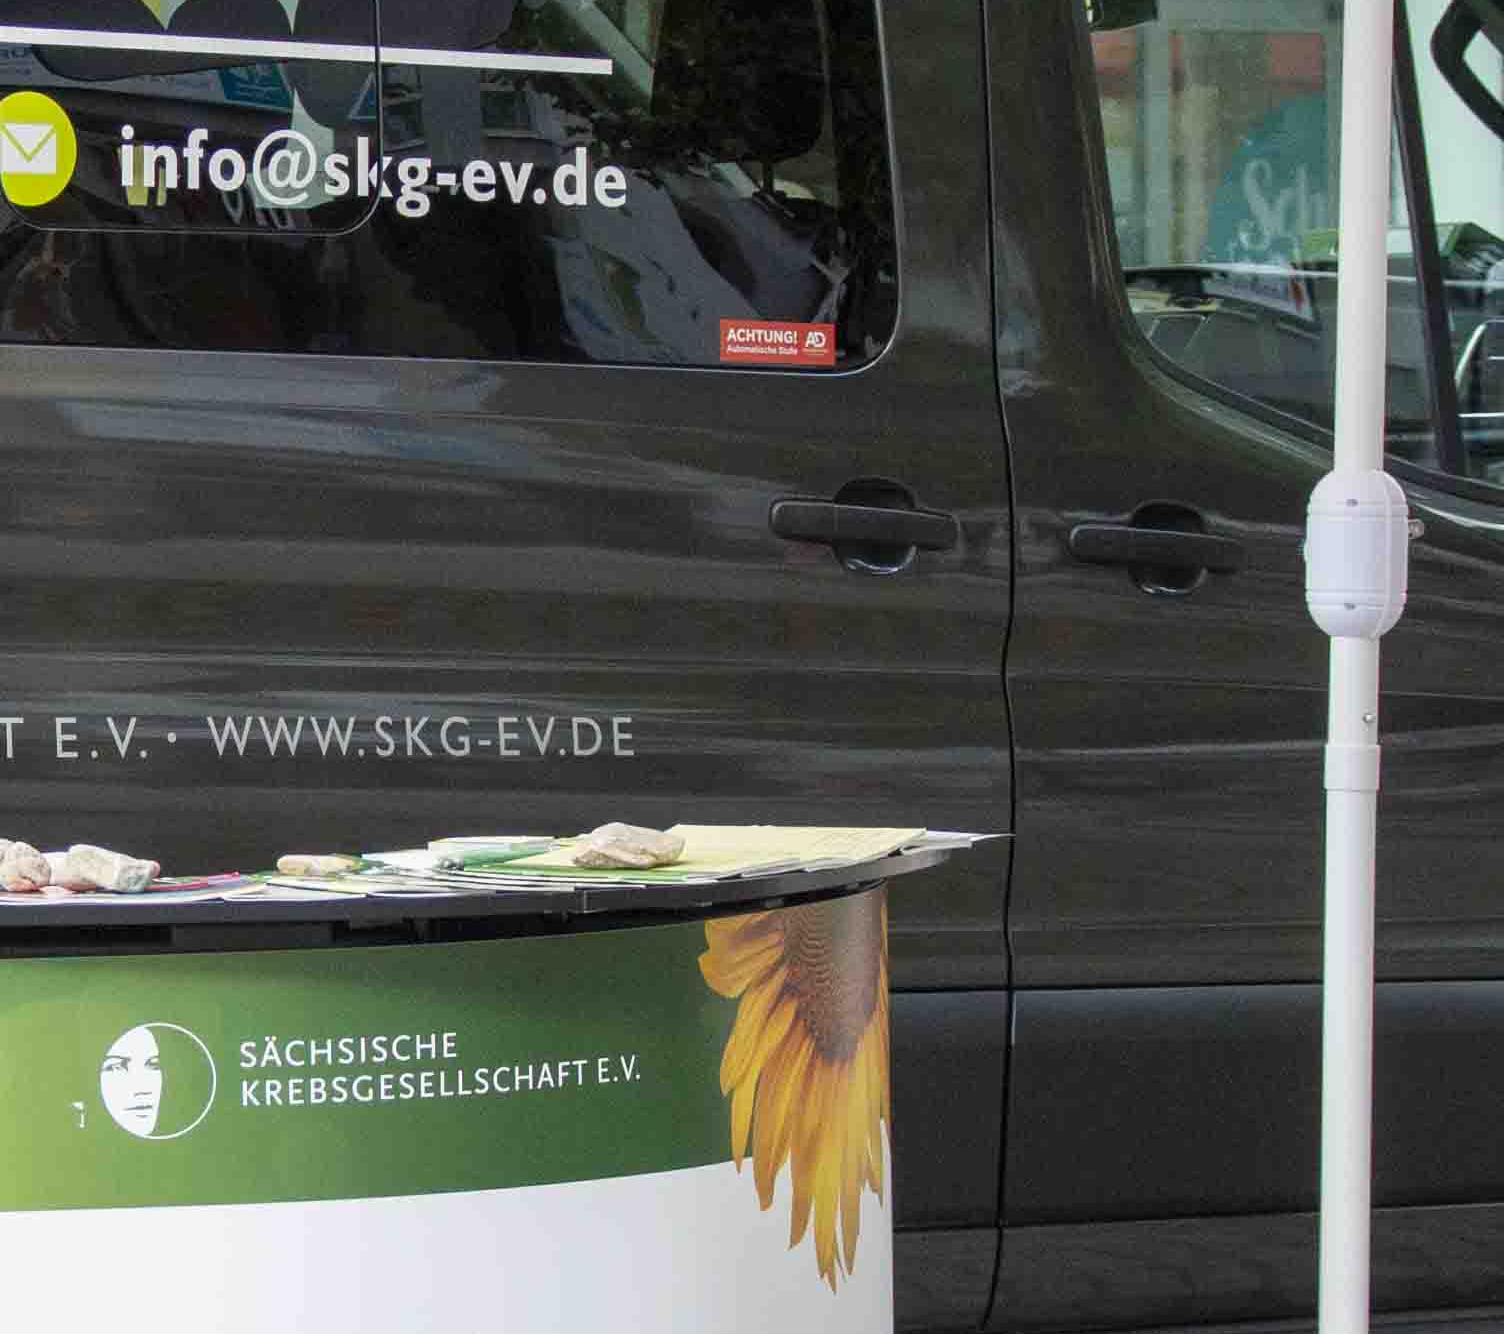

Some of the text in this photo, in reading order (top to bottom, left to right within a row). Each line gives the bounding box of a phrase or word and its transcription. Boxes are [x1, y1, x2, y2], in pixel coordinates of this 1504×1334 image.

[119, 124, 627, 218] info@skg-ev.de
[726, 328, 798, 345] ACHTUNG!
[54, 716, 149, 760] E.V.
[207, 715, 636, 759] WWW.SKG-EV.DE
[240, 1032, 458, 1069] SÄCHSISCHE
[242, 1055, 642, 1107] KREBSGESELLSCHAFT E.V.
